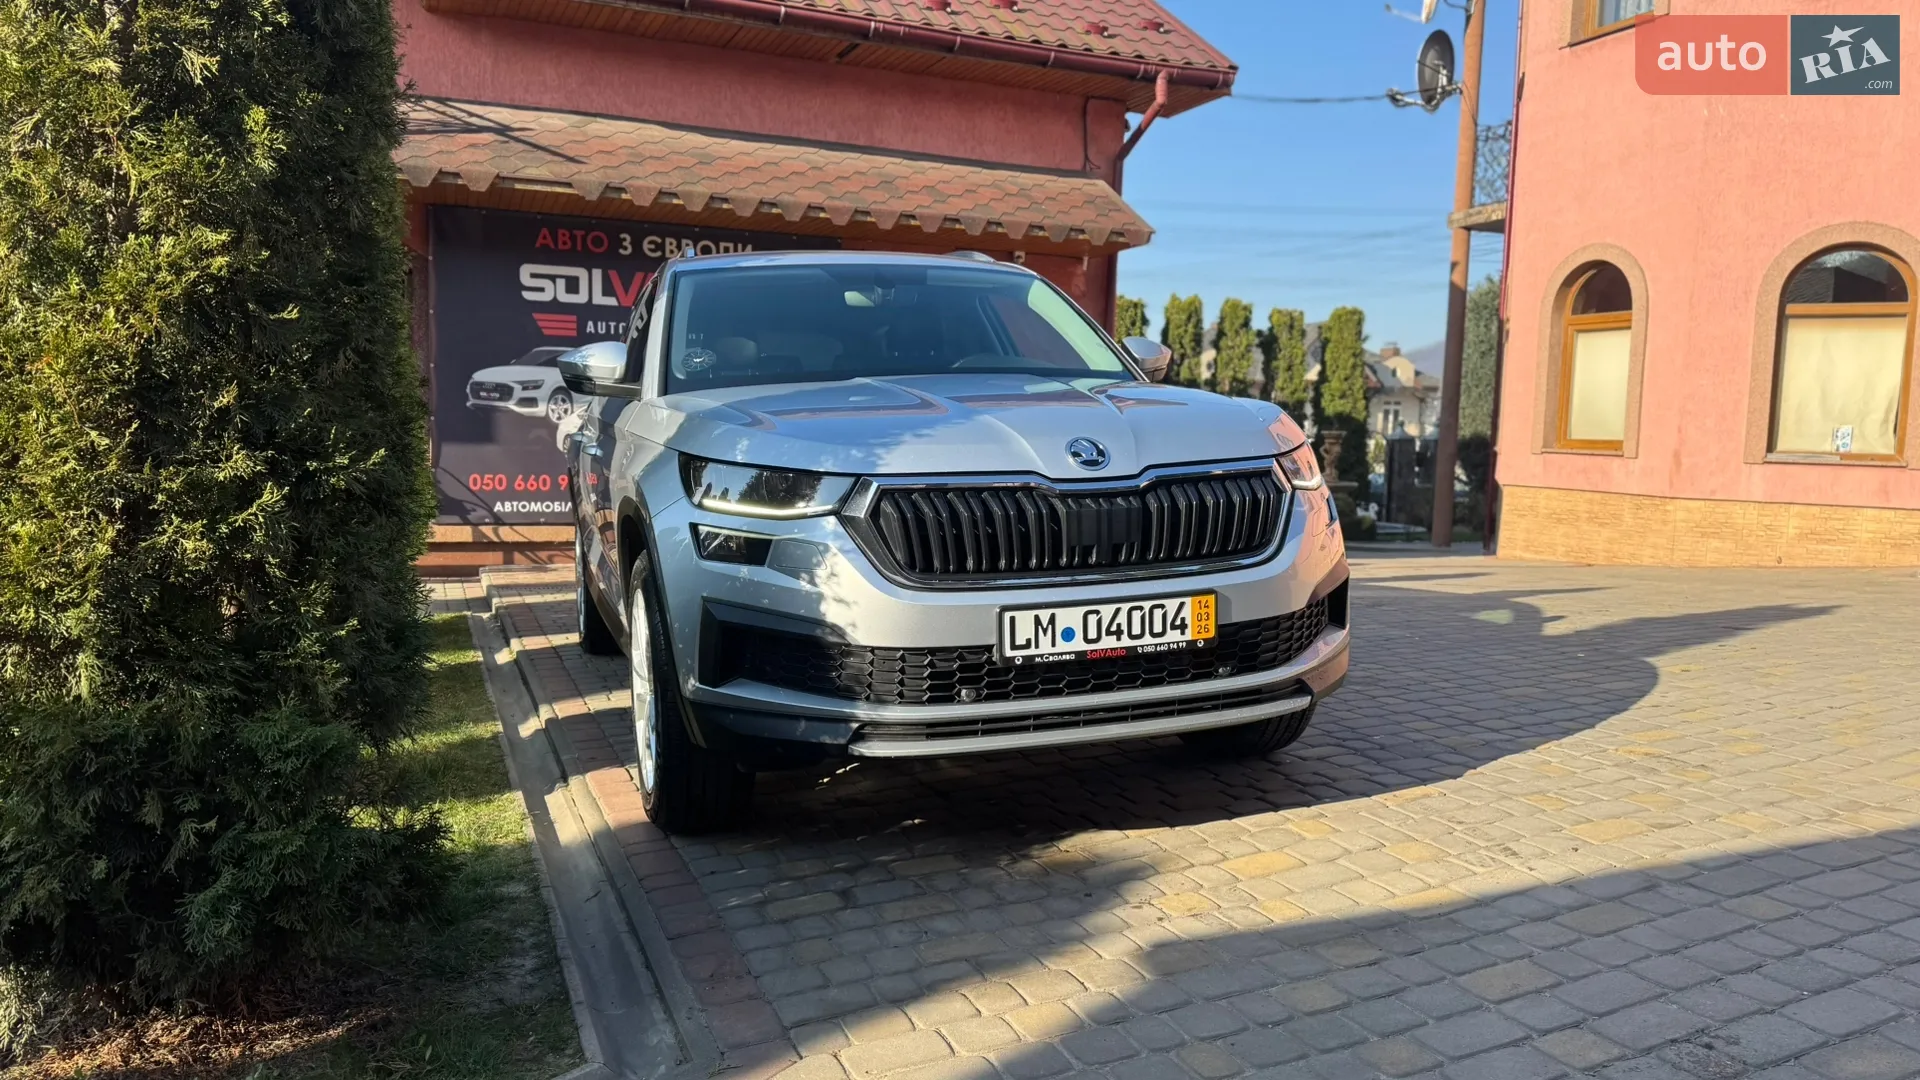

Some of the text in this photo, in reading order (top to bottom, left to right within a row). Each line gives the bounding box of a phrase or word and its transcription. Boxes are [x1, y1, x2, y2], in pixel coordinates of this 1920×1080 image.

[535, 227, 609, 253] АВТО
[618, 233, 633, 256] З
[519, 263, 656, 307] SOLV
[468, 473, 507, 491] 050
[514, 474, 551, 491] 660
[1197, 599, 1210, 610] 14
[1196, 611, 1210, 622] 03
[1009, 601, 1188, 651] LM 04004
[1196, 623, 1210, 634] 26
[1143, 641, 1187, 653] 050 660 94 99
[1086, 648, 1127, 659] SolVAuto
